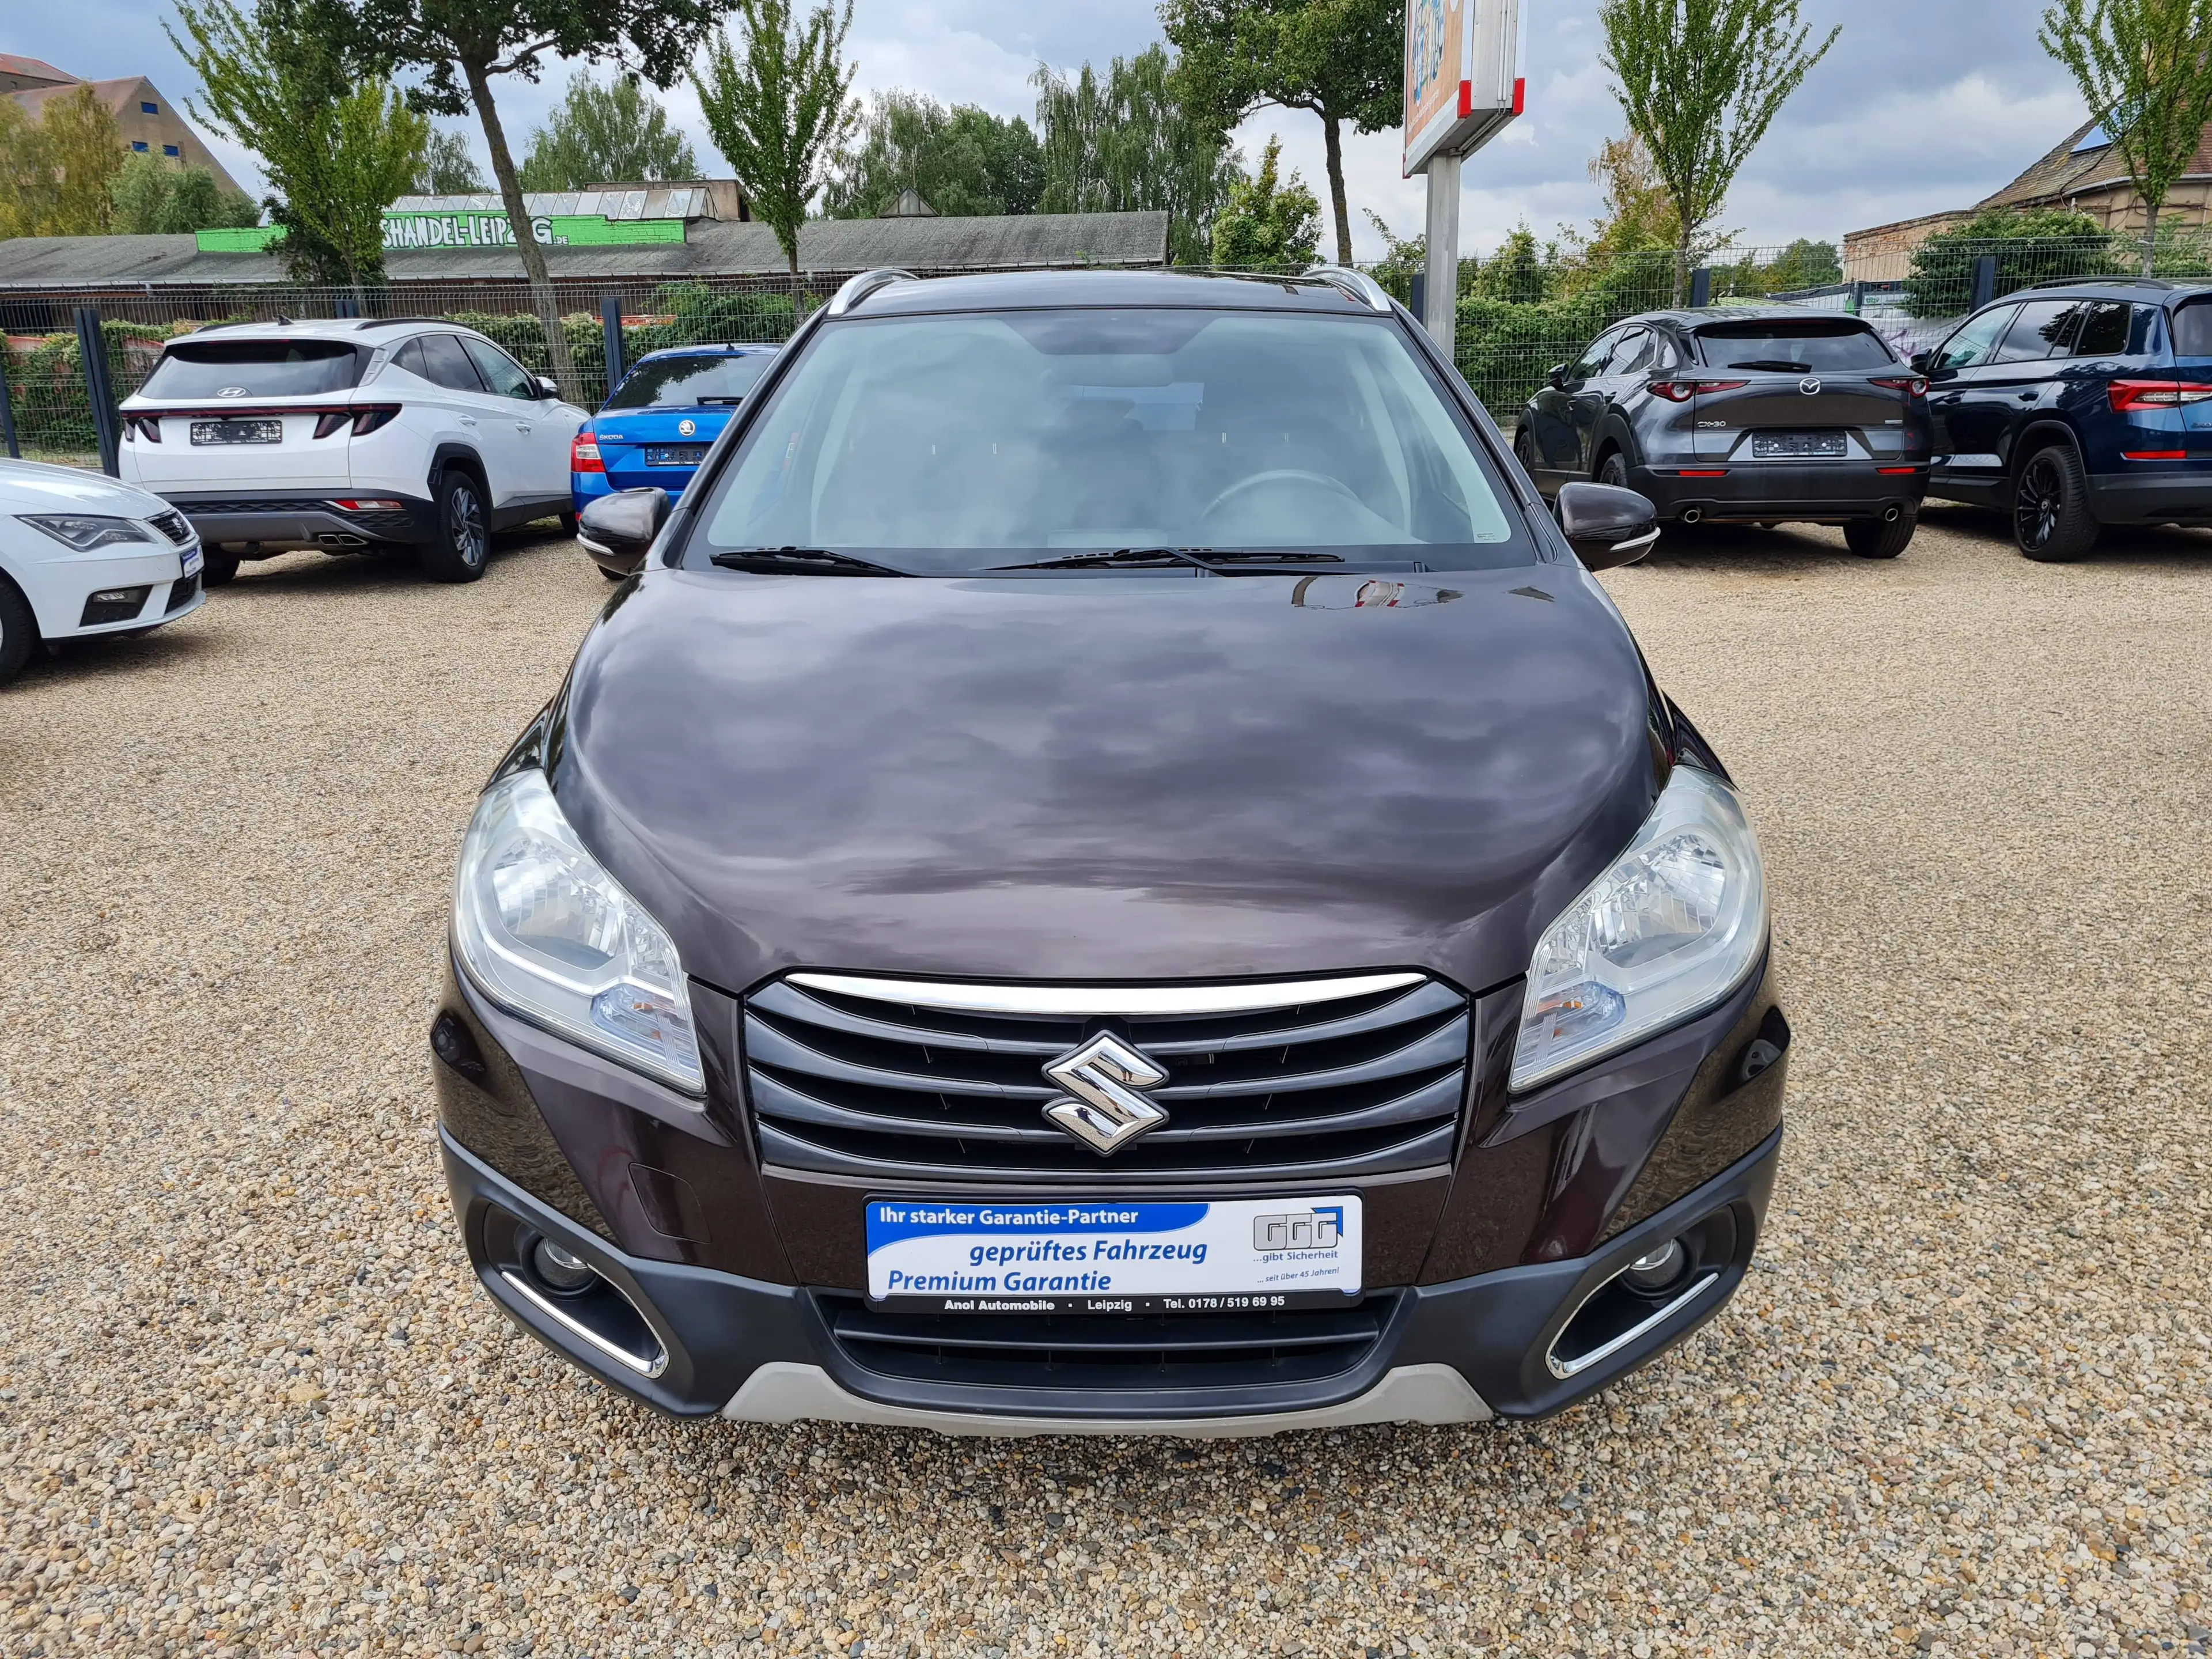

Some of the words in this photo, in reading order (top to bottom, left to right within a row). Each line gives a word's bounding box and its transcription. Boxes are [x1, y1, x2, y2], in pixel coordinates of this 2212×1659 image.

[880, 1207, 906, 1223] Ihr
[910, 1209, 975, 1225] starker
[979, 1209, 1138, 1225] Garantie-Partner
[969, 1240, 1086, 1266] geprüftes
[1093, 1239, 1207, 1264] Fahrzeug
[1287, 1251, 1338, 1260] Sicherheit
[888, 1270, 997, 1291] Premium
[1003, 1271, 1111, 1291] Garantie
[1266, 1274, 1279, 1282] seit
[1281, 1272, 1298, 1281] über
[1310, 1267, 1339, 1277] Jahren!
[944, 1300, 975, 1310] Anol
[978, 1300, 1055, 1310] Automobile
[1088, 1300, 1132, 1312] Leipzig
[1163, 1298, 1185, 1309] Tel.
[1252, 1296, 1267, 1306] 69
[1270, 1296, 1285, 1306] 95
